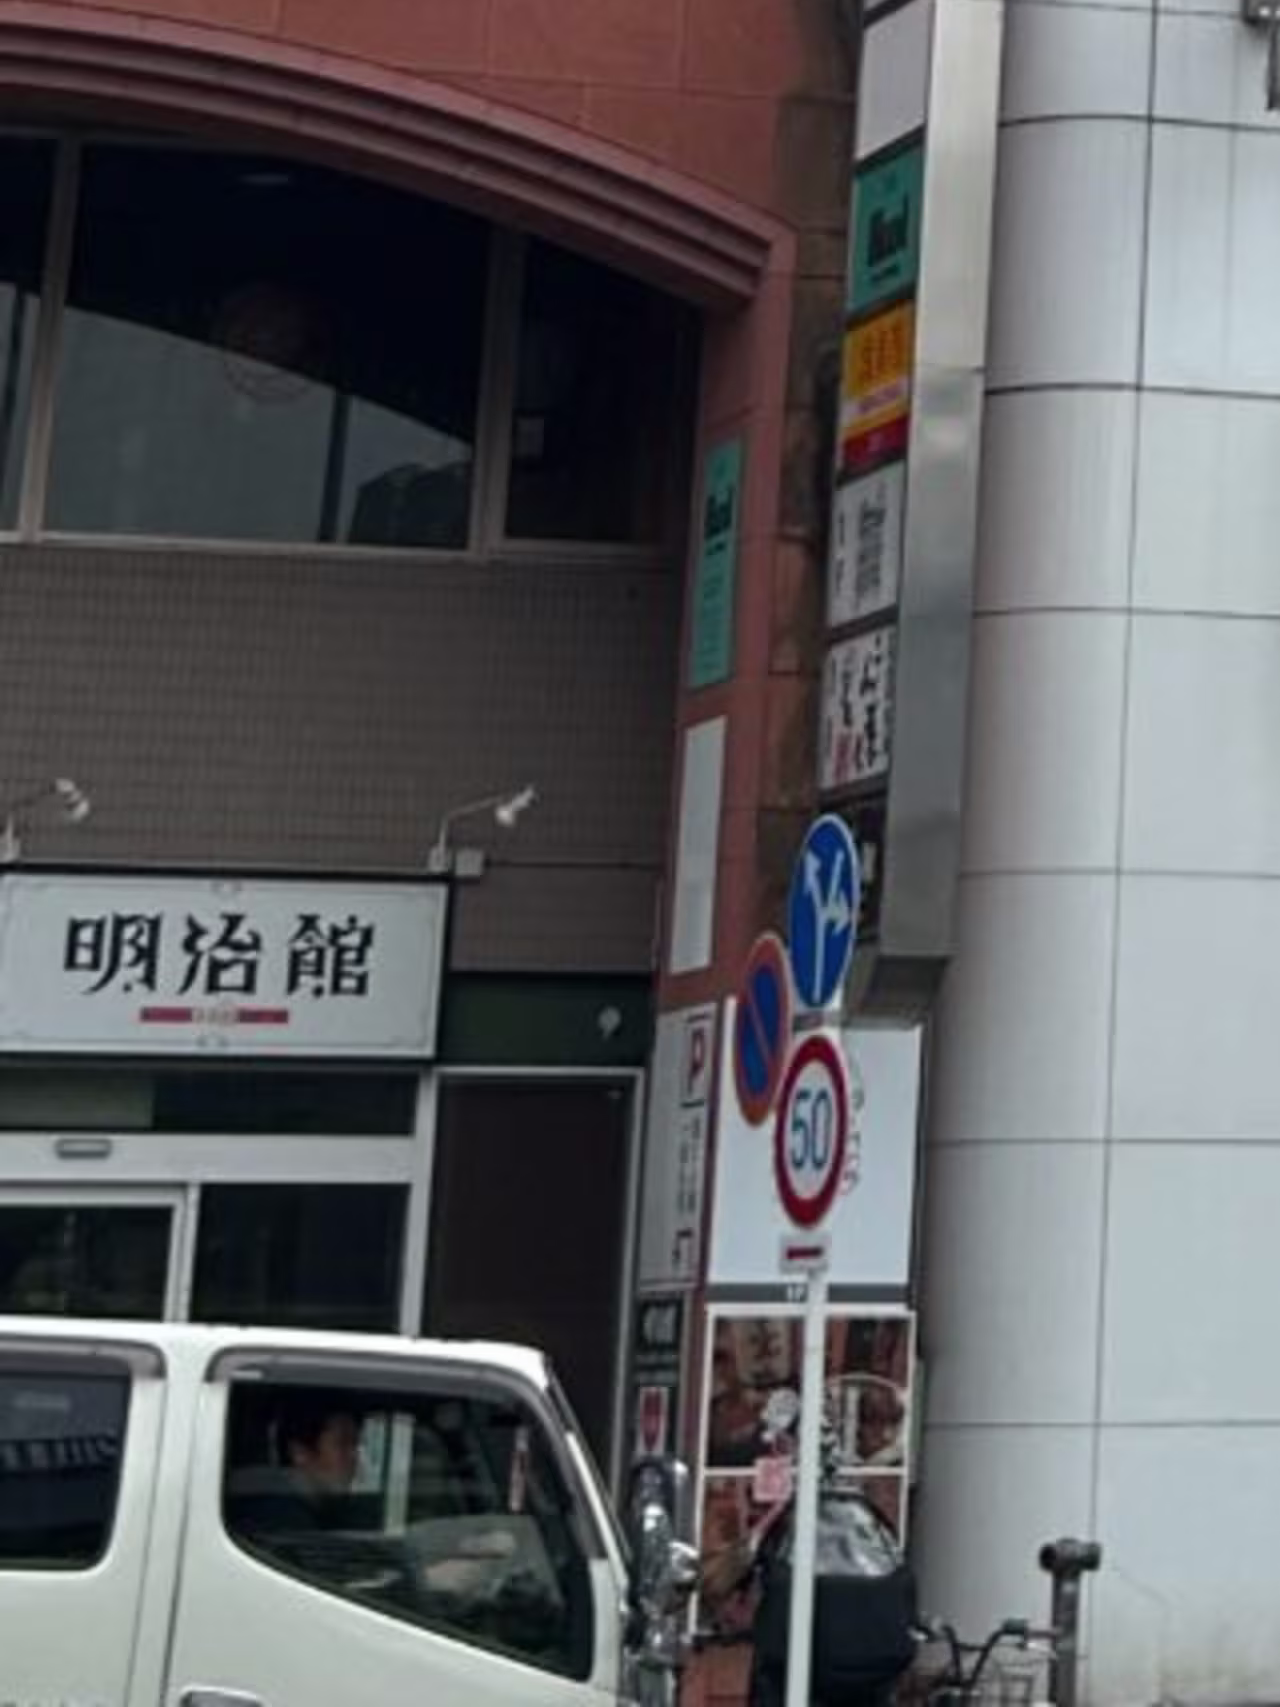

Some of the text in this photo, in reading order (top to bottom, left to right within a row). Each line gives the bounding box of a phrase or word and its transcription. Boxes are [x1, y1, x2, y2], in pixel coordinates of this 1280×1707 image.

[62, 911, 376, 999] 明治館
[790, 1089, 832, 1169] 50
